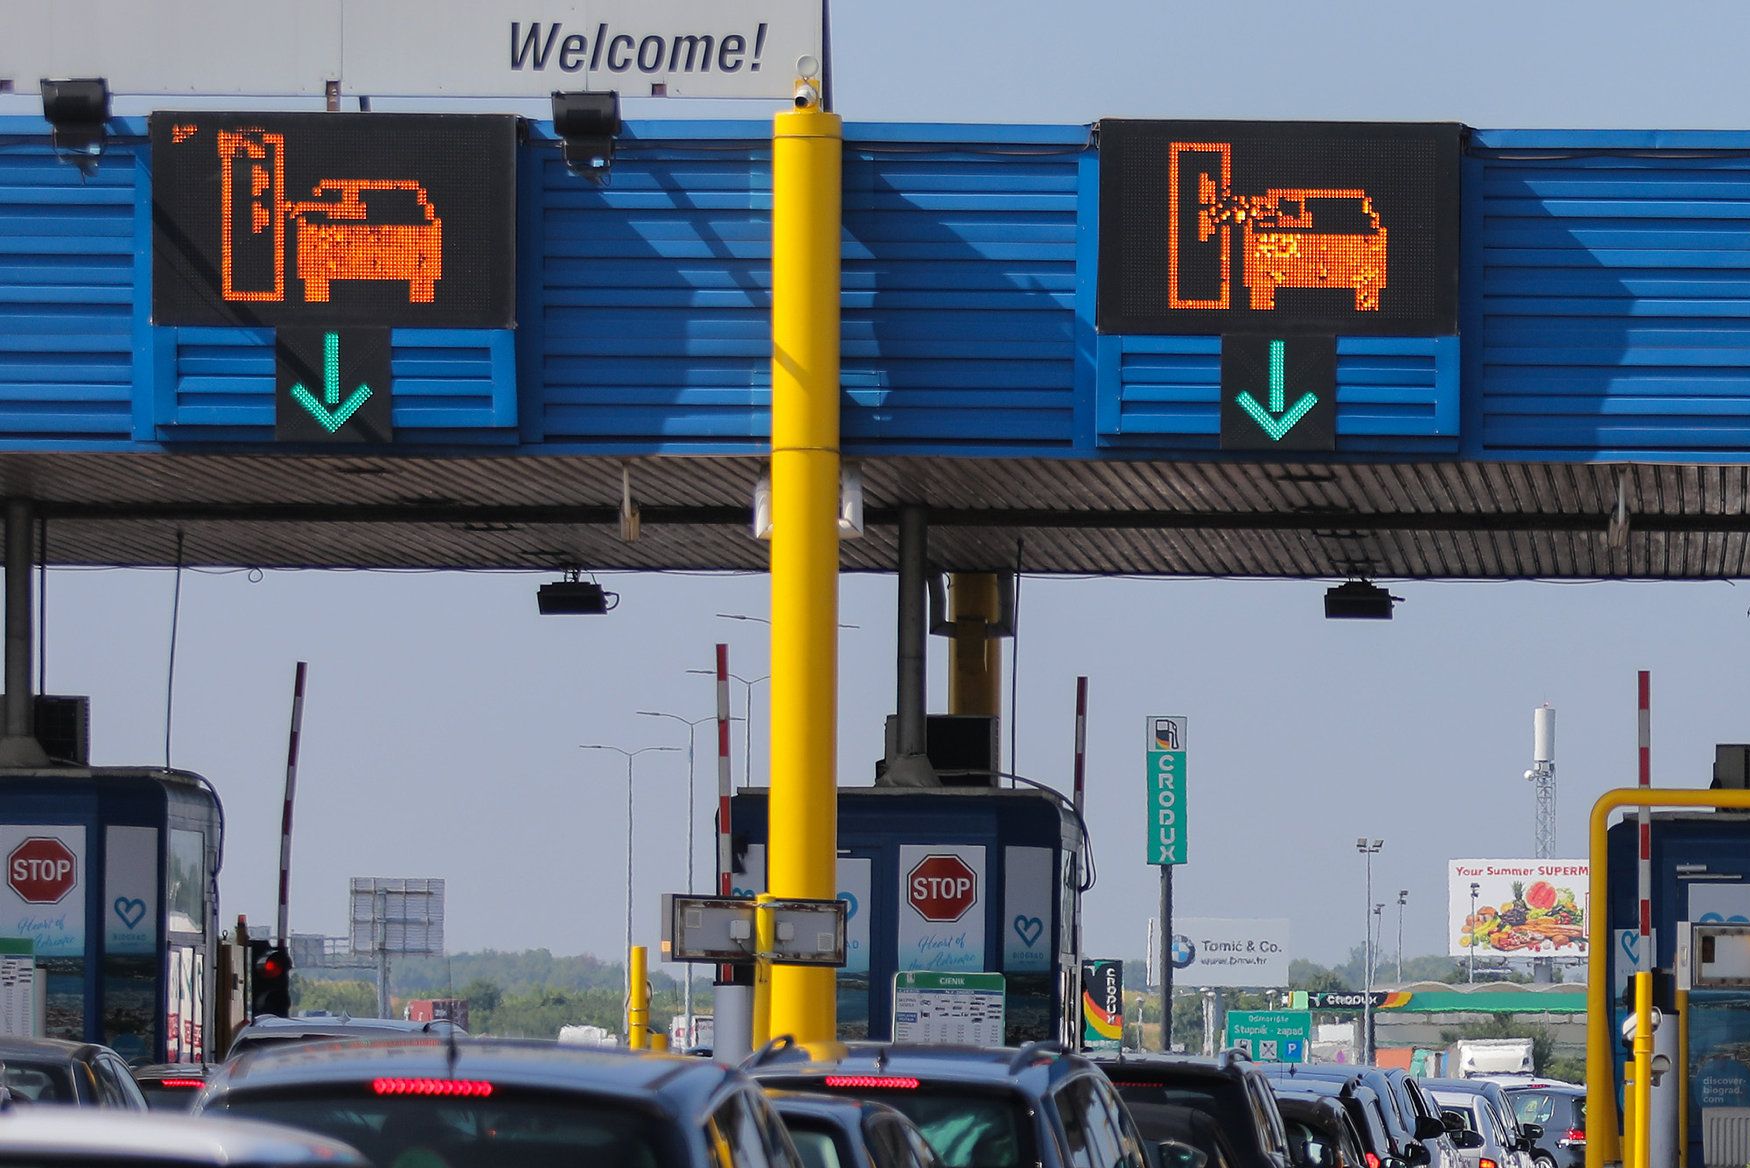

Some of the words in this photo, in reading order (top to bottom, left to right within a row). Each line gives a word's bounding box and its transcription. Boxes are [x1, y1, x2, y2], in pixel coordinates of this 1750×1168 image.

[511, 22, 768, 73] Welcome!
[1158, 754, 1176, 862] CRODUX
[13, 859, 71, 881] STOP
[1456, 866, 1483, 876] Your
[1486, 866, 1534, 876] Summer
[1537, 866, 1589, 876] SUPERM
[913, 877, 971, 900] STOP
[1201, 940, 1243, 952] Tomić
[1246, 941, 1256, 952] &
[1259, 941, 1283, 953] Co.
[1326, 996, 1377, 1005] CRODUX
[1287, 1043, 1297, 1054] P
[1703, 1076, 1747, 1085] discover-
[1703, 1086, 1743, 1096] biograd.
